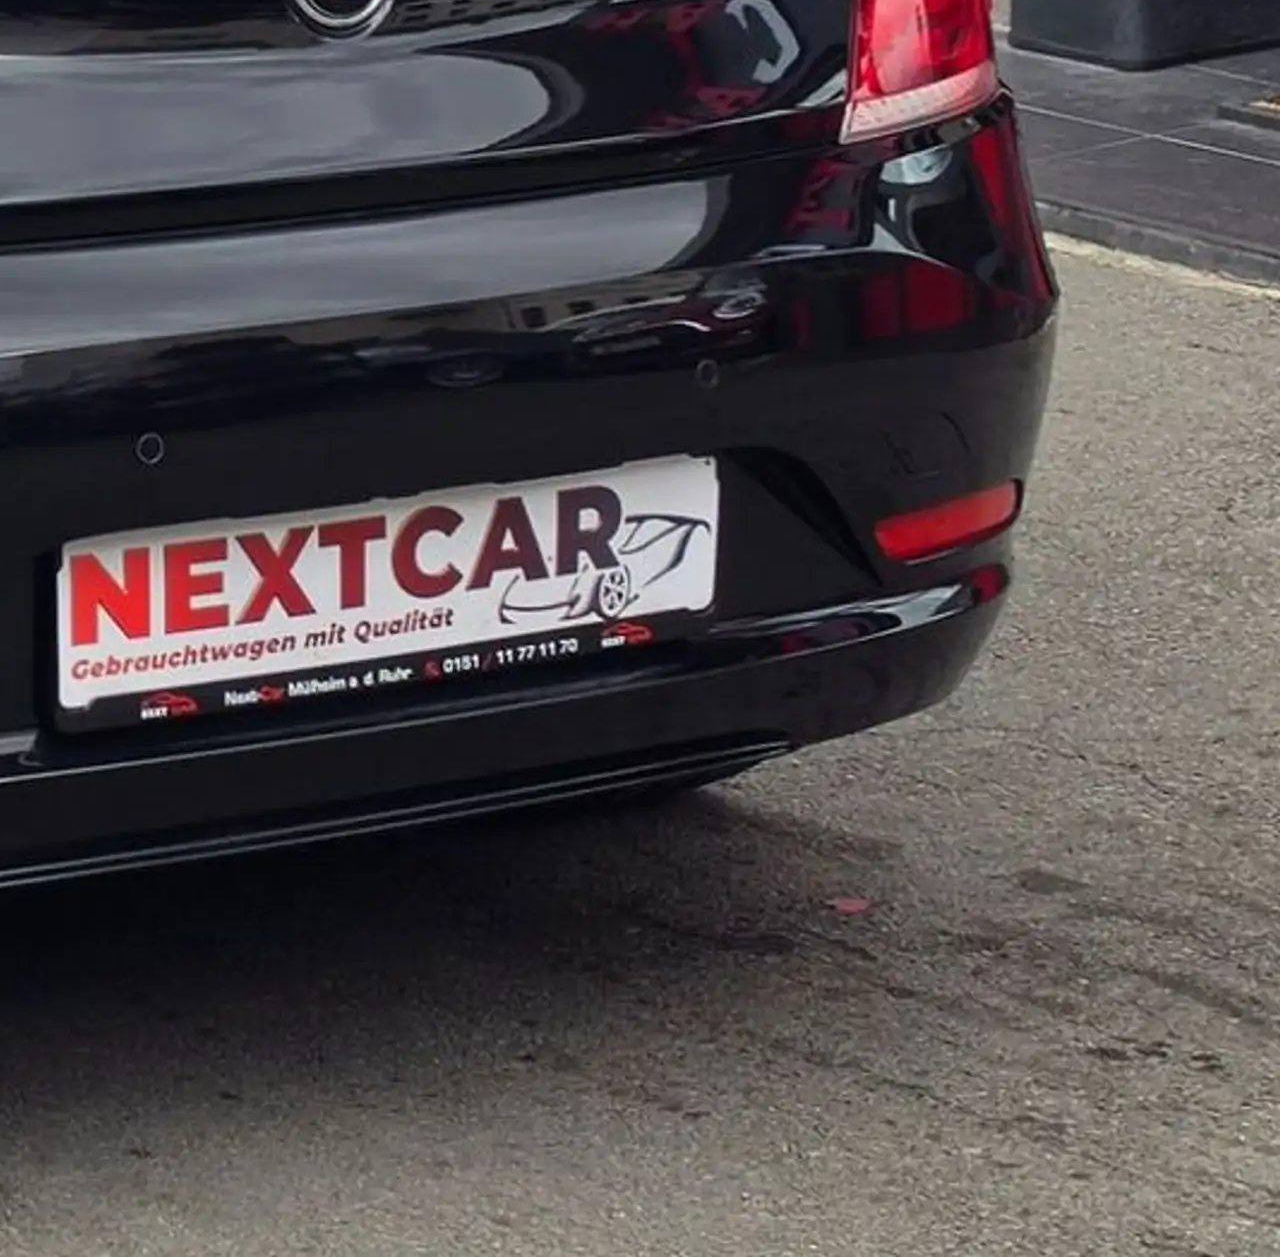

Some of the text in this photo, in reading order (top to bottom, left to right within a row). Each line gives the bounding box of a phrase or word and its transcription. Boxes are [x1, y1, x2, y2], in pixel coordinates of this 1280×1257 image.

[69, 484, 622, 646] NEXTCAR
[71, 607, 453, 681] Gebrauchtwagen mit Qualität
